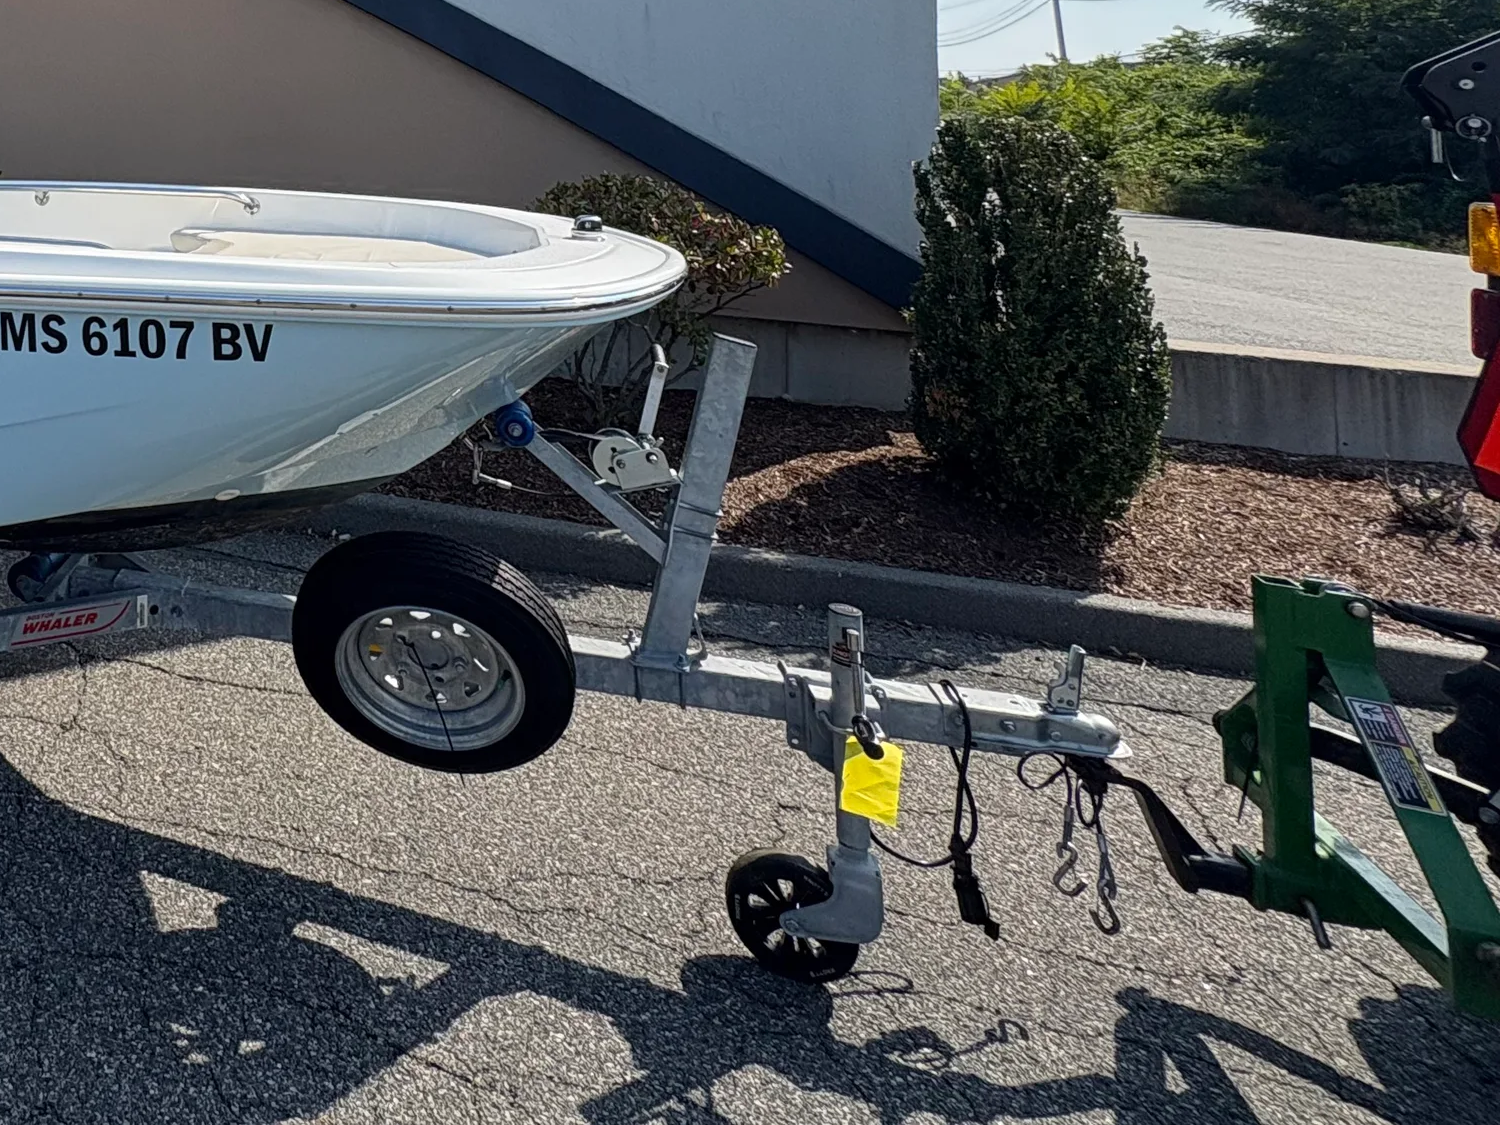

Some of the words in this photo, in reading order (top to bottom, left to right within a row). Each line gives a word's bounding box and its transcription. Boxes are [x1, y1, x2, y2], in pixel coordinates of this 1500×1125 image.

[0, 311, 68, 354] MS
[82, 316, 194, 359] 6107
[212, 321, 274, 362] BV
[22, 612, 98, 635] WHALER
[26, 612, 55, 622] BOSTON
